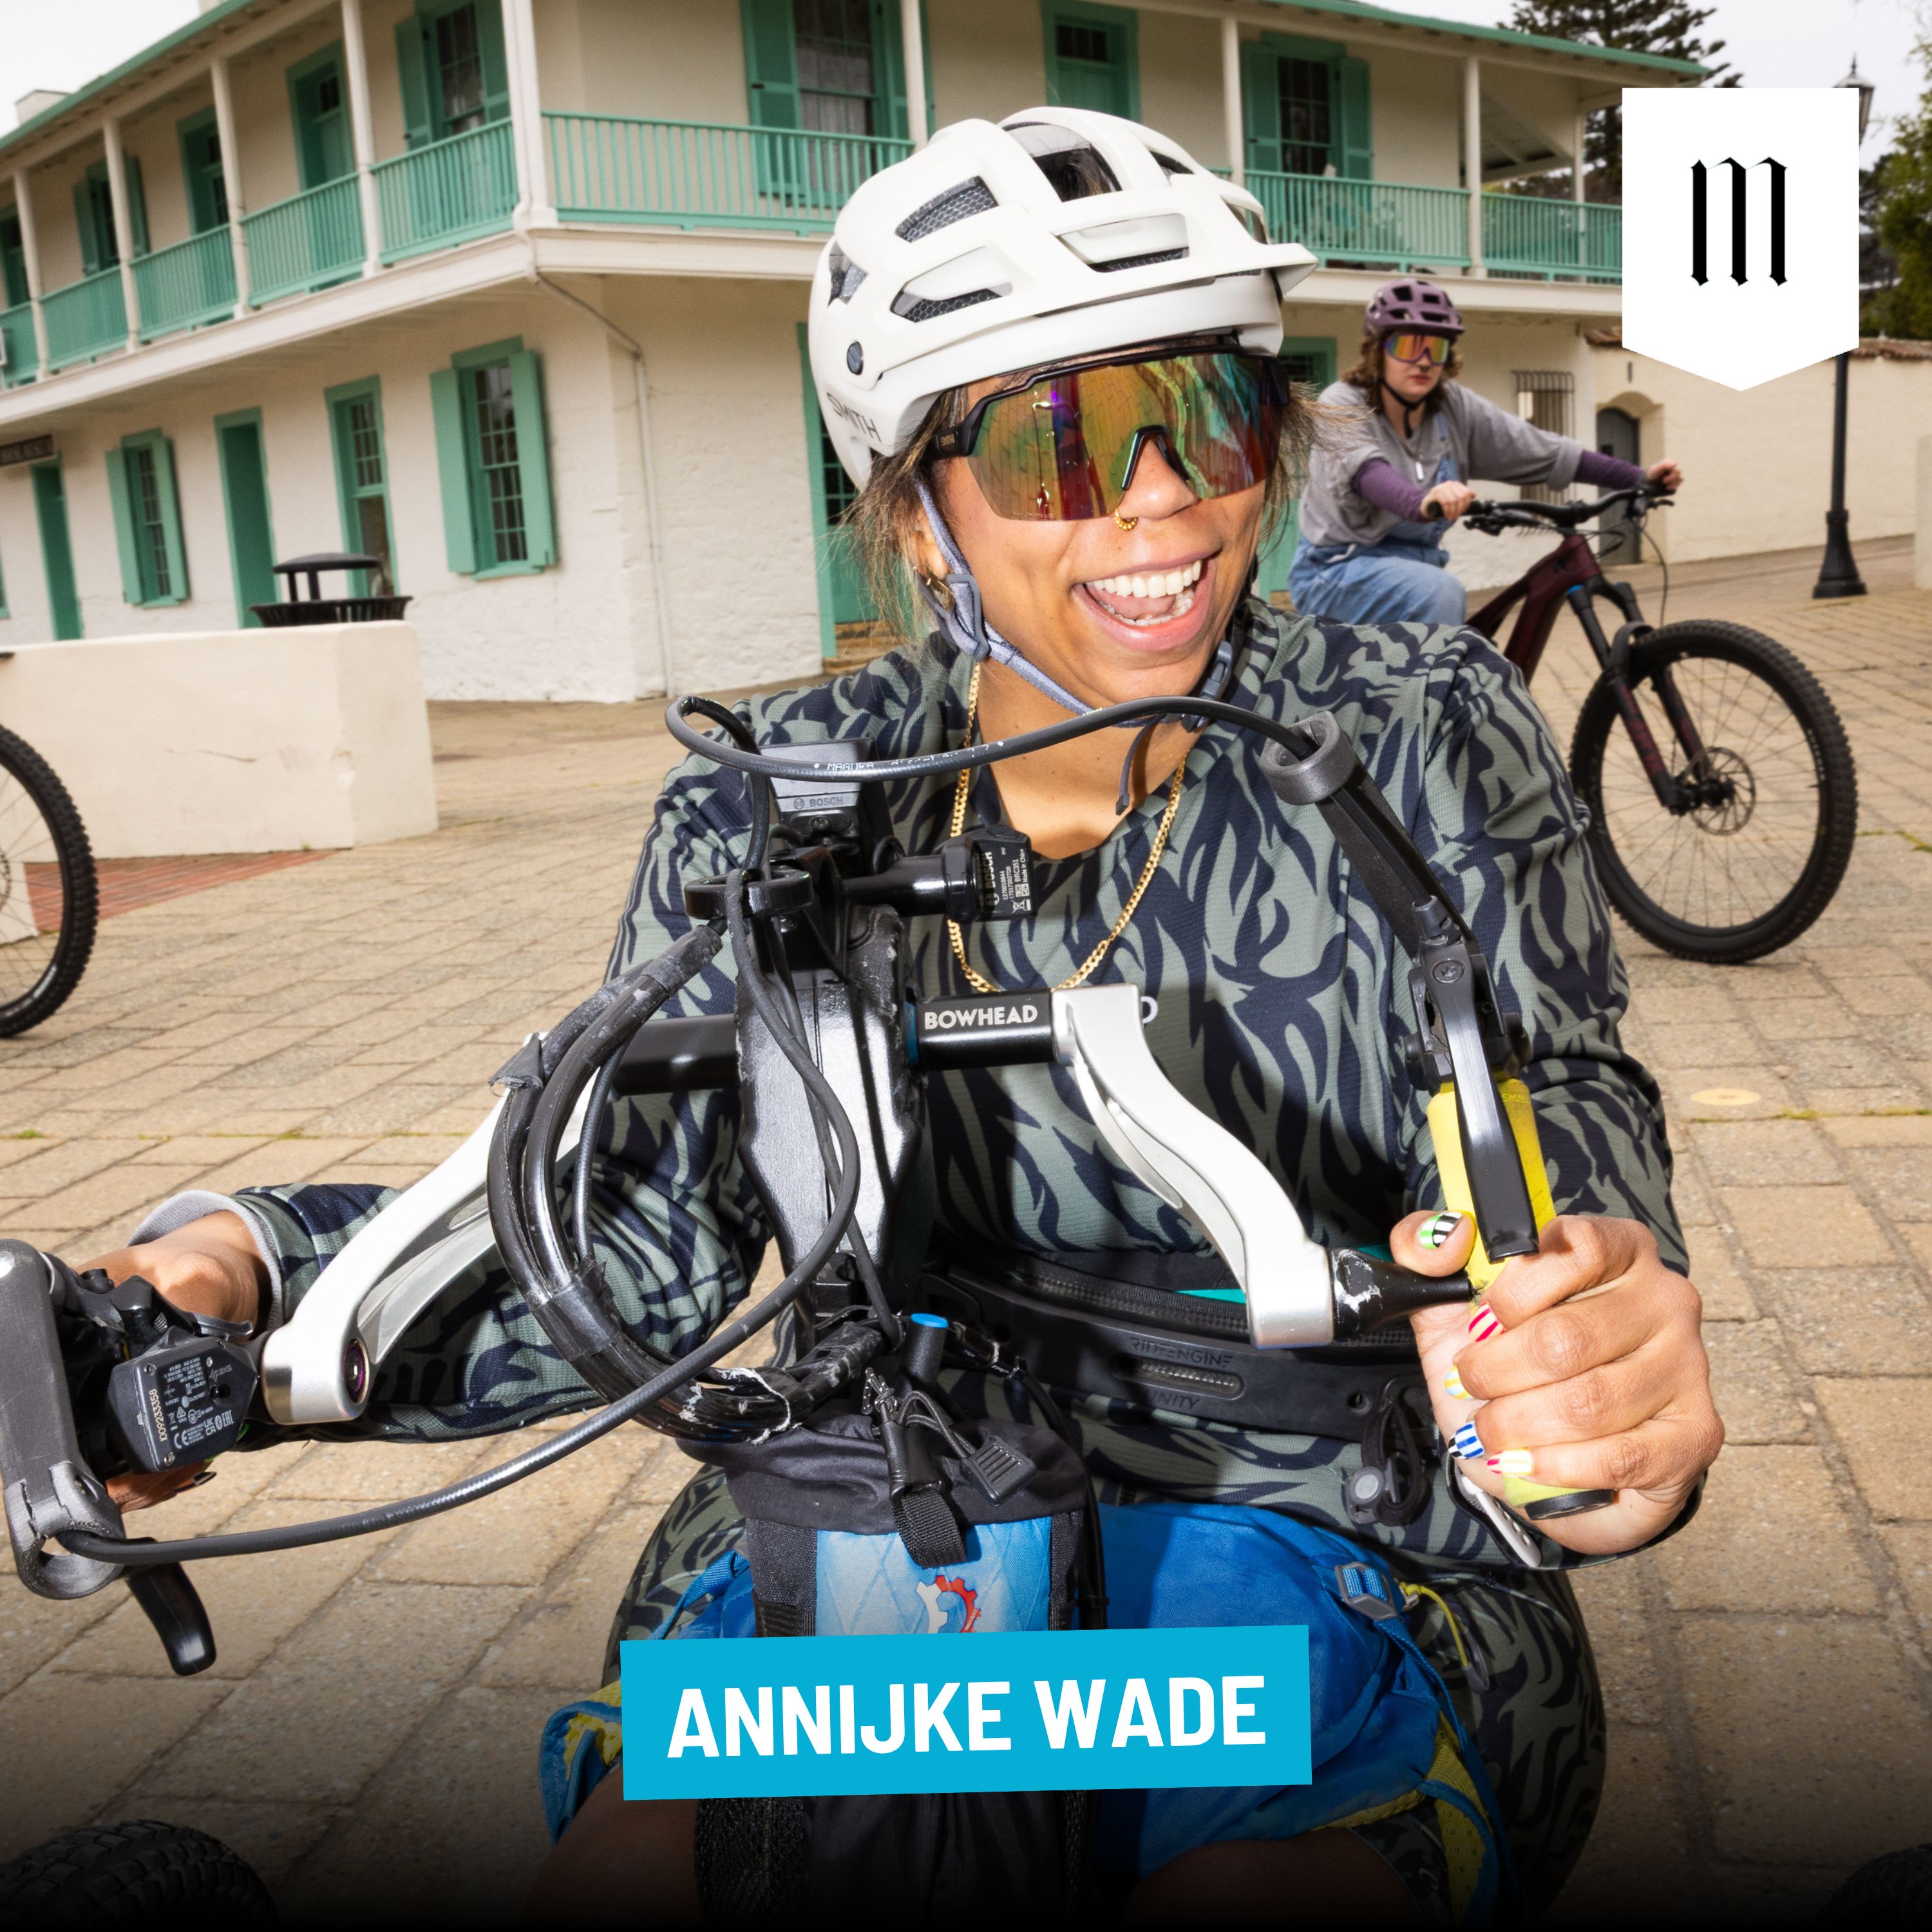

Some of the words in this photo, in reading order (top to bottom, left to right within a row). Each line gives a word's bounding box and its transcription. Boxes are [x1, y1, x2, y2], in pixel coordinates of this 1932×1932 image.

[827, 392, 882, 442] SMITH
[810, 797, 843, 807] BOSCH
[981, 851, 996, 888] BOSCH
[924, 1005, 1038, 1030] BOWHEAD
[149, 1388, 168, 1443] 1009233358
